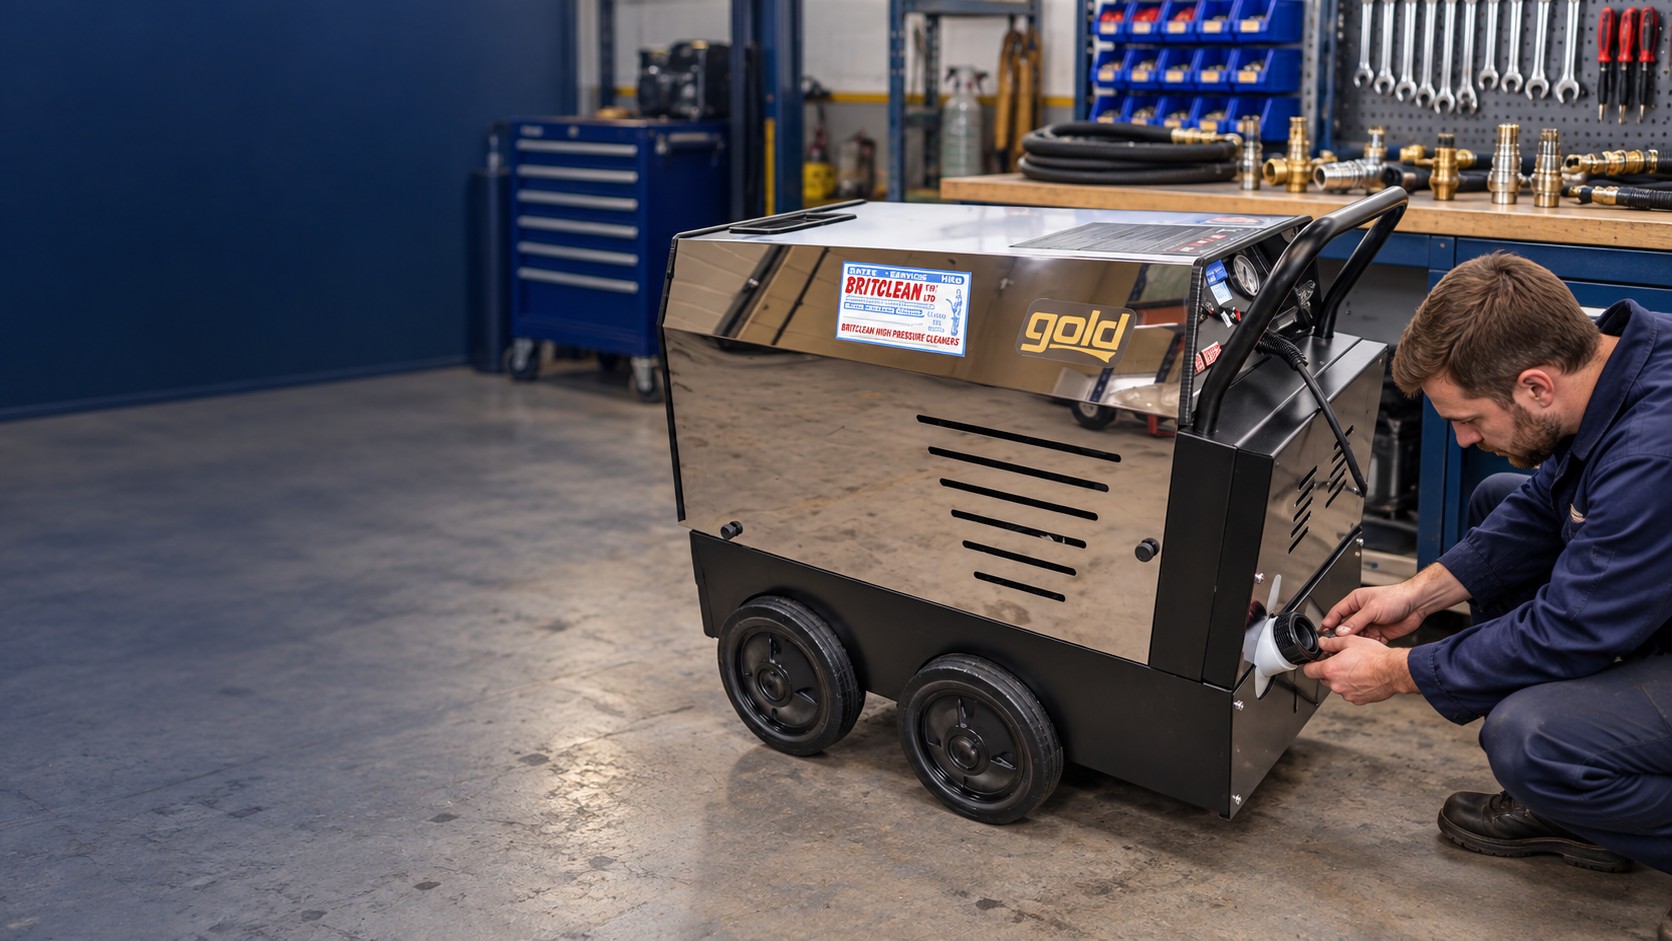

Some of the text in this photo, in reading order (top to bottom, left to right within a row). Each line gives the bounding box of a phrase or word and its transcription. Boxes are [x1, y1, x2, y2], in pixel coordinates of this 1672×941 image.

[845, 276, 923, 301] BRITCLEAN
[841, 323, 960, 346] BRITCLEAN HIGH PRESSURE CLEANERS
[1021, 310, 1130, 353] gold
